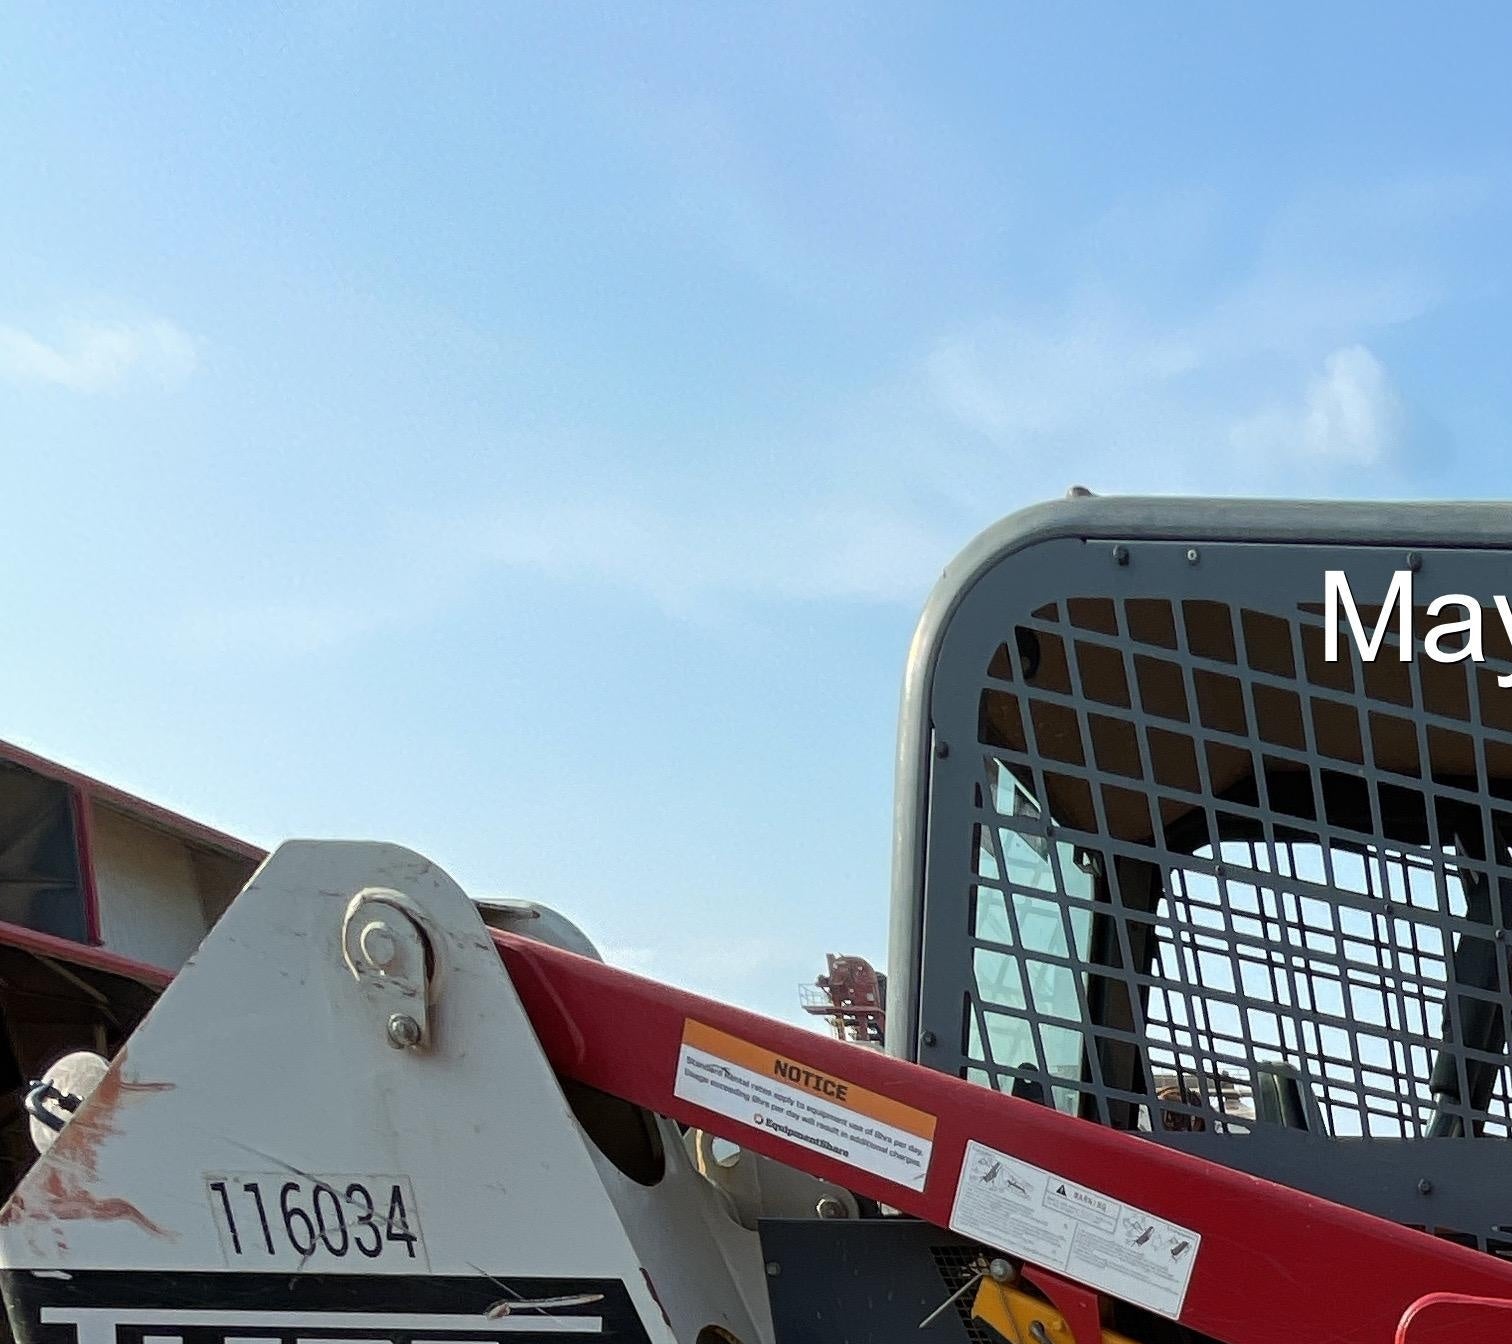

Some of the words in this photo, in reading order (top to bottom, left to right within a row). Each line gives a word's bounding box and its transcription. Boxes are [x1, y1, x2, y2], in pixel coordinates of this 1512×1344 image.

[774, 1059, 849, 1102] NOTICE
[764, 1118, 849, 1157] EquipmentShare
[208, 1178, 419, 1260] 116034
